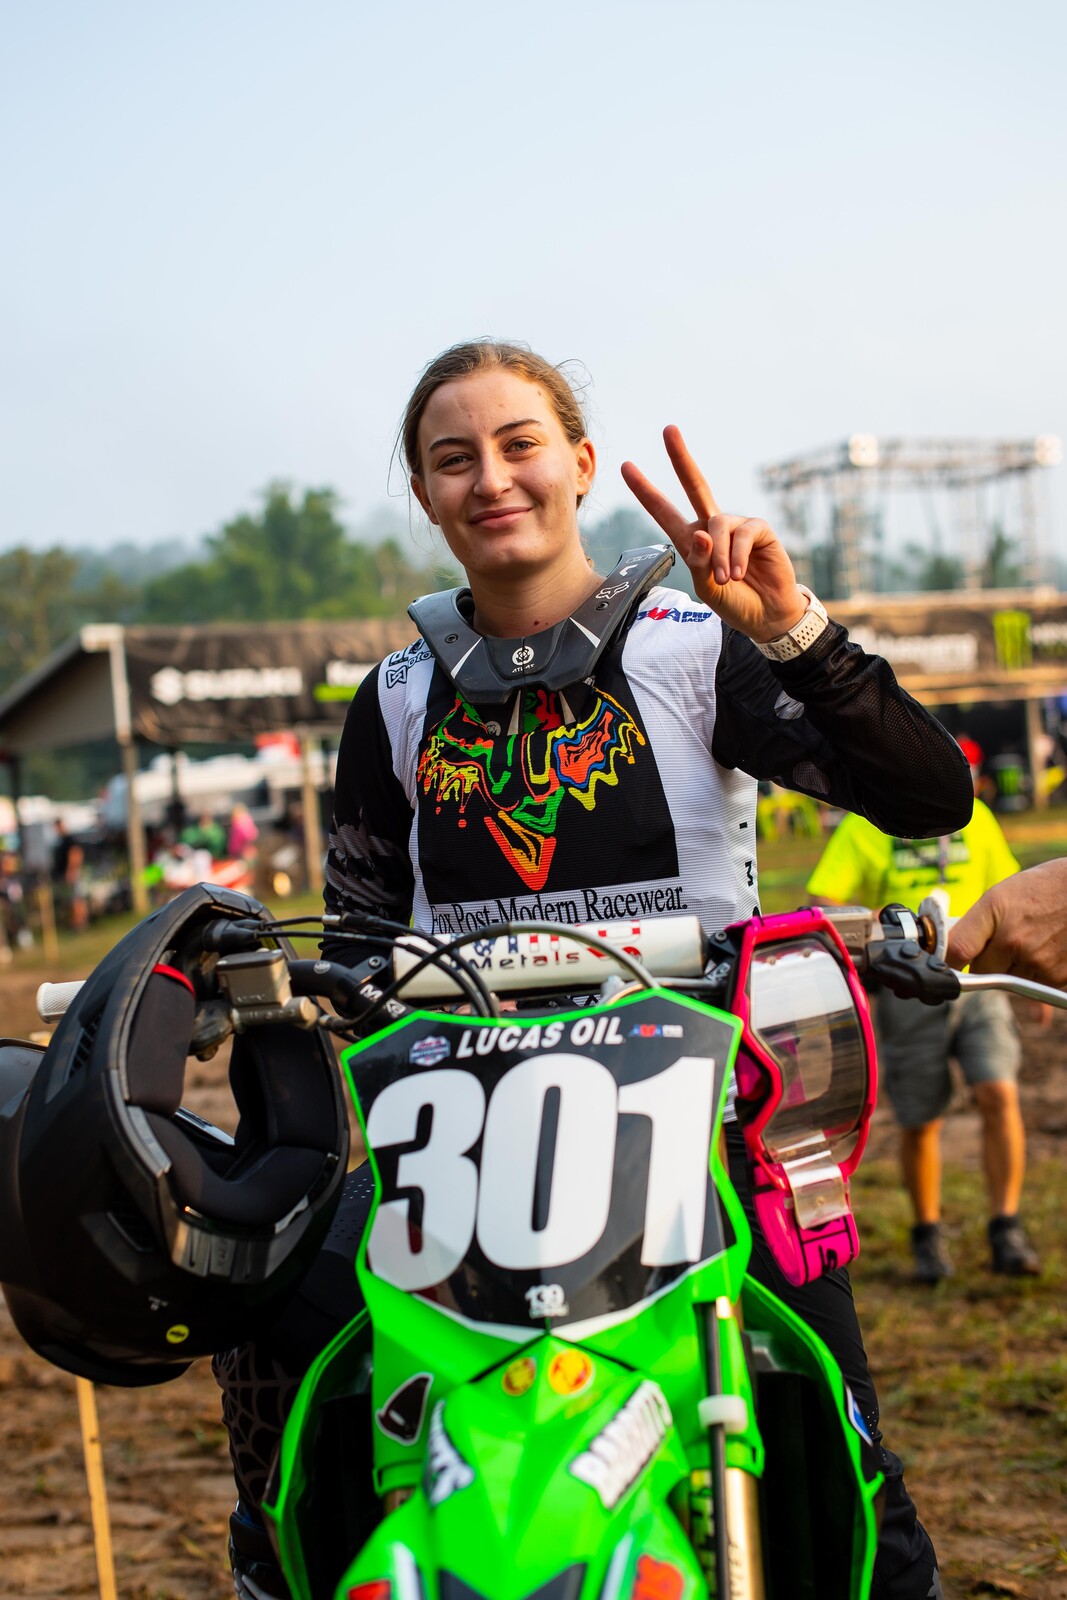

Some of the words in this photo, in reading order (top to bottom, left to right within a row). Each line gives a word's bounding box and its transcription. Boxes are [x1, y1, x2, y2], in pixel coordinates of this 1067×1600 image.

[430, 904, 455, 935] Fox
[451, 893, 581, 934] Post-Modern
[468, 950, 580, 970] Metals
[455, 1021, 564, 1059] LUCAS
[569, 1016, 624, 1046] OIL
[366, 1052, 715, 1292] 301
